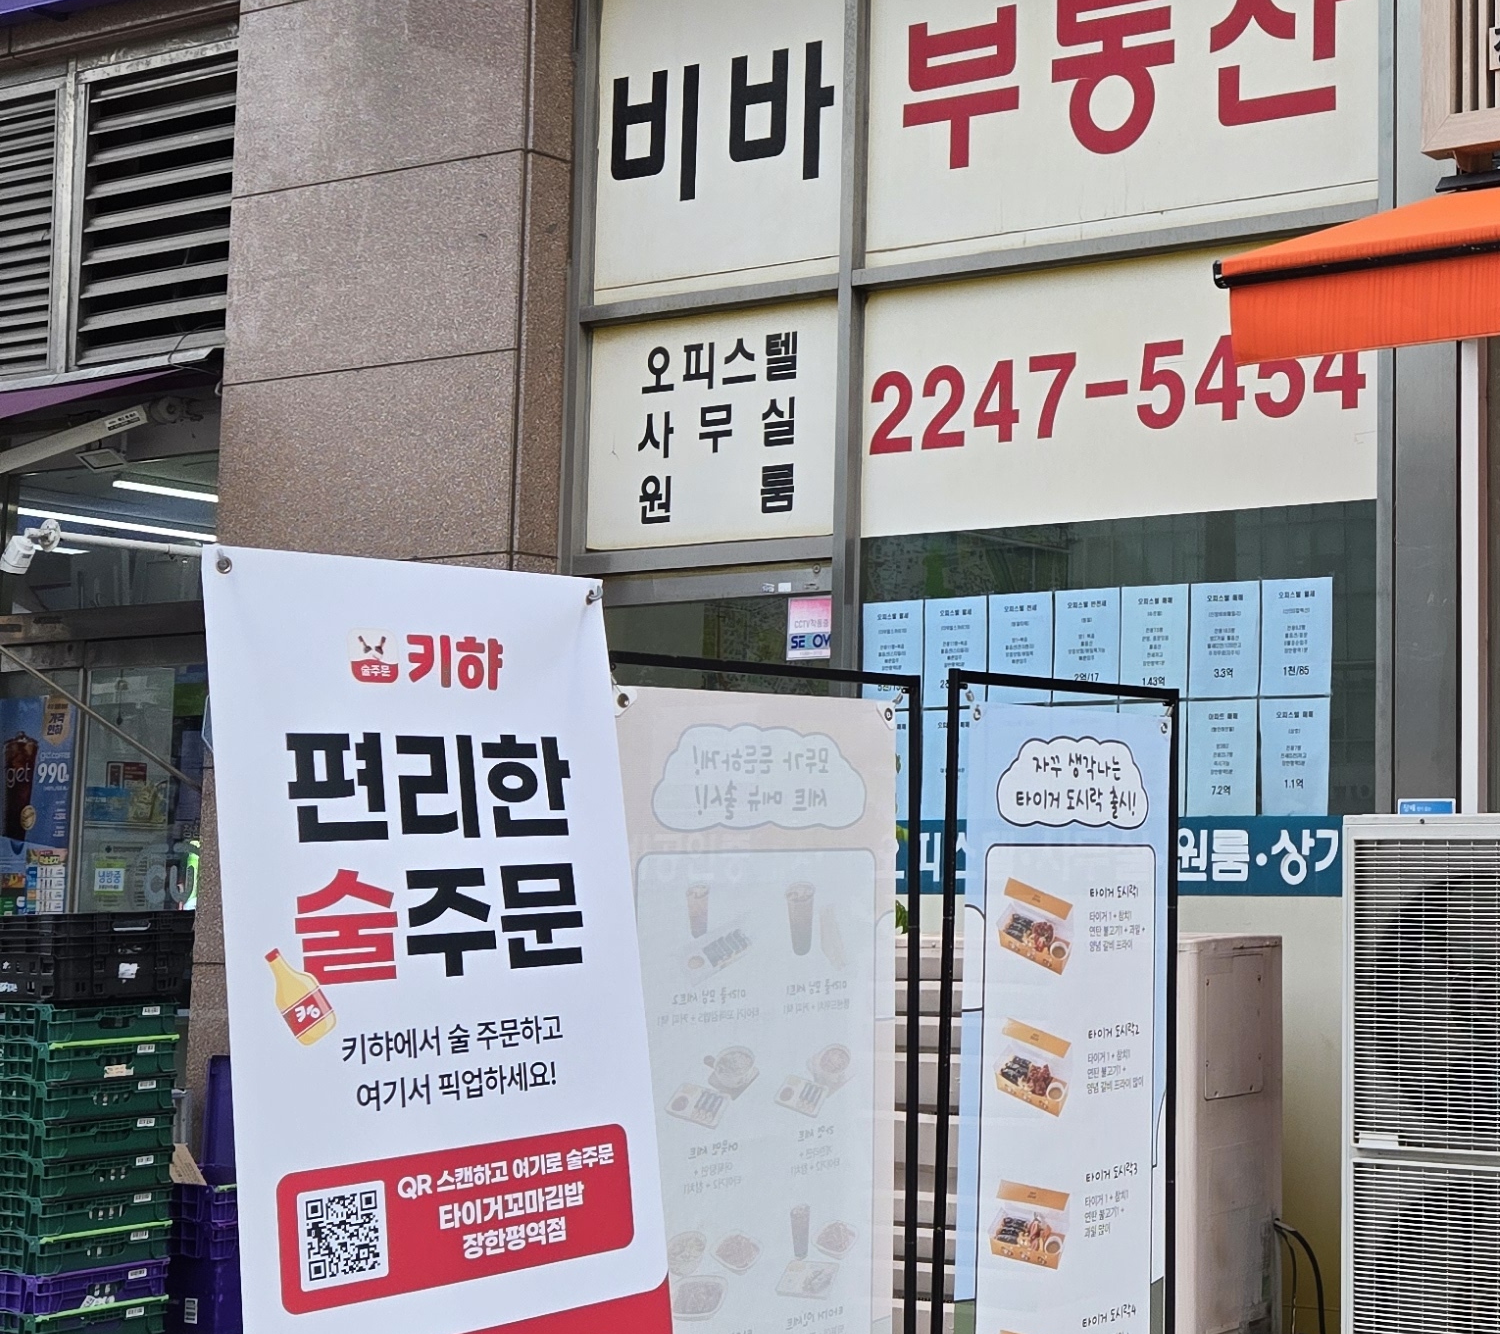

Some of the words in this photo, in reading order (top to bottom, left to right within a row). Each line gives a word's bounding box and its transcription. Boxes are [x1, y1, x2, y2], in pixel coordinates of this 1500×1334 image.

[610, 41, 834, 201] 비바
[641, 331, 798, 395] 오피스텔
[869, 335, 1366, 455] 2247-5454
[637, 396, 796, 458] 사무실
[638, 464, 795, 525] 원룸
[360, 664, 391, 678] 술주문
[407, 633, 503, 690] 키햐
[46, 724, 63, 736] 인하
[7, 766, 30, 788] get
[285, 732, 571, 843] 편리한
[1032, 755, 1062, 778] 자꾸
[1068, 753, 1121, 781] 생각나는
[1016, 789, 1060, 810] 타이거
[1067, 787, 1103, 813] 도시락
[1110, 785, 1136, 820] 출시!
[1089, 887, 1114, 899] 타이거
[1089, 911, 1107, 922] 타이거
[294, 863, 584, 986] 술주문
[341, 1025, 441, 1066] 키햐에서
[447, 1029, 471, 1054] 술
[476, 1015, 564, 1052] 주문하고
[1088, 1027, 1112, 1039] 타이거
[1115, 1022, 1140, 1038] 도시락2
[1087, 1052, 1105, 1063] 타이거
[356, 1078, 432, 1112] 여기서
[438, 1061, 557, 1100] 픽업하세요!
[397, 1174, 433, 1201] QR
[436, 1161, 509, 1194] 스캔하고
[512, 1153, 563, 1178] 여기로
[565, 1142, 614, 1172] 술주문
[1086, 1169, 1111, 1182] 타이거
[1113, 1162, 1138, 1179] 도시락3
[438, 1182, 585, 1231] 타이거꼬마김밥
[462, 1218, 567, 1260] 장한평역점
[1082, 1312, 1108, 1327] 타이거
[1110, 1303, 1136, 1322] 도시락4
